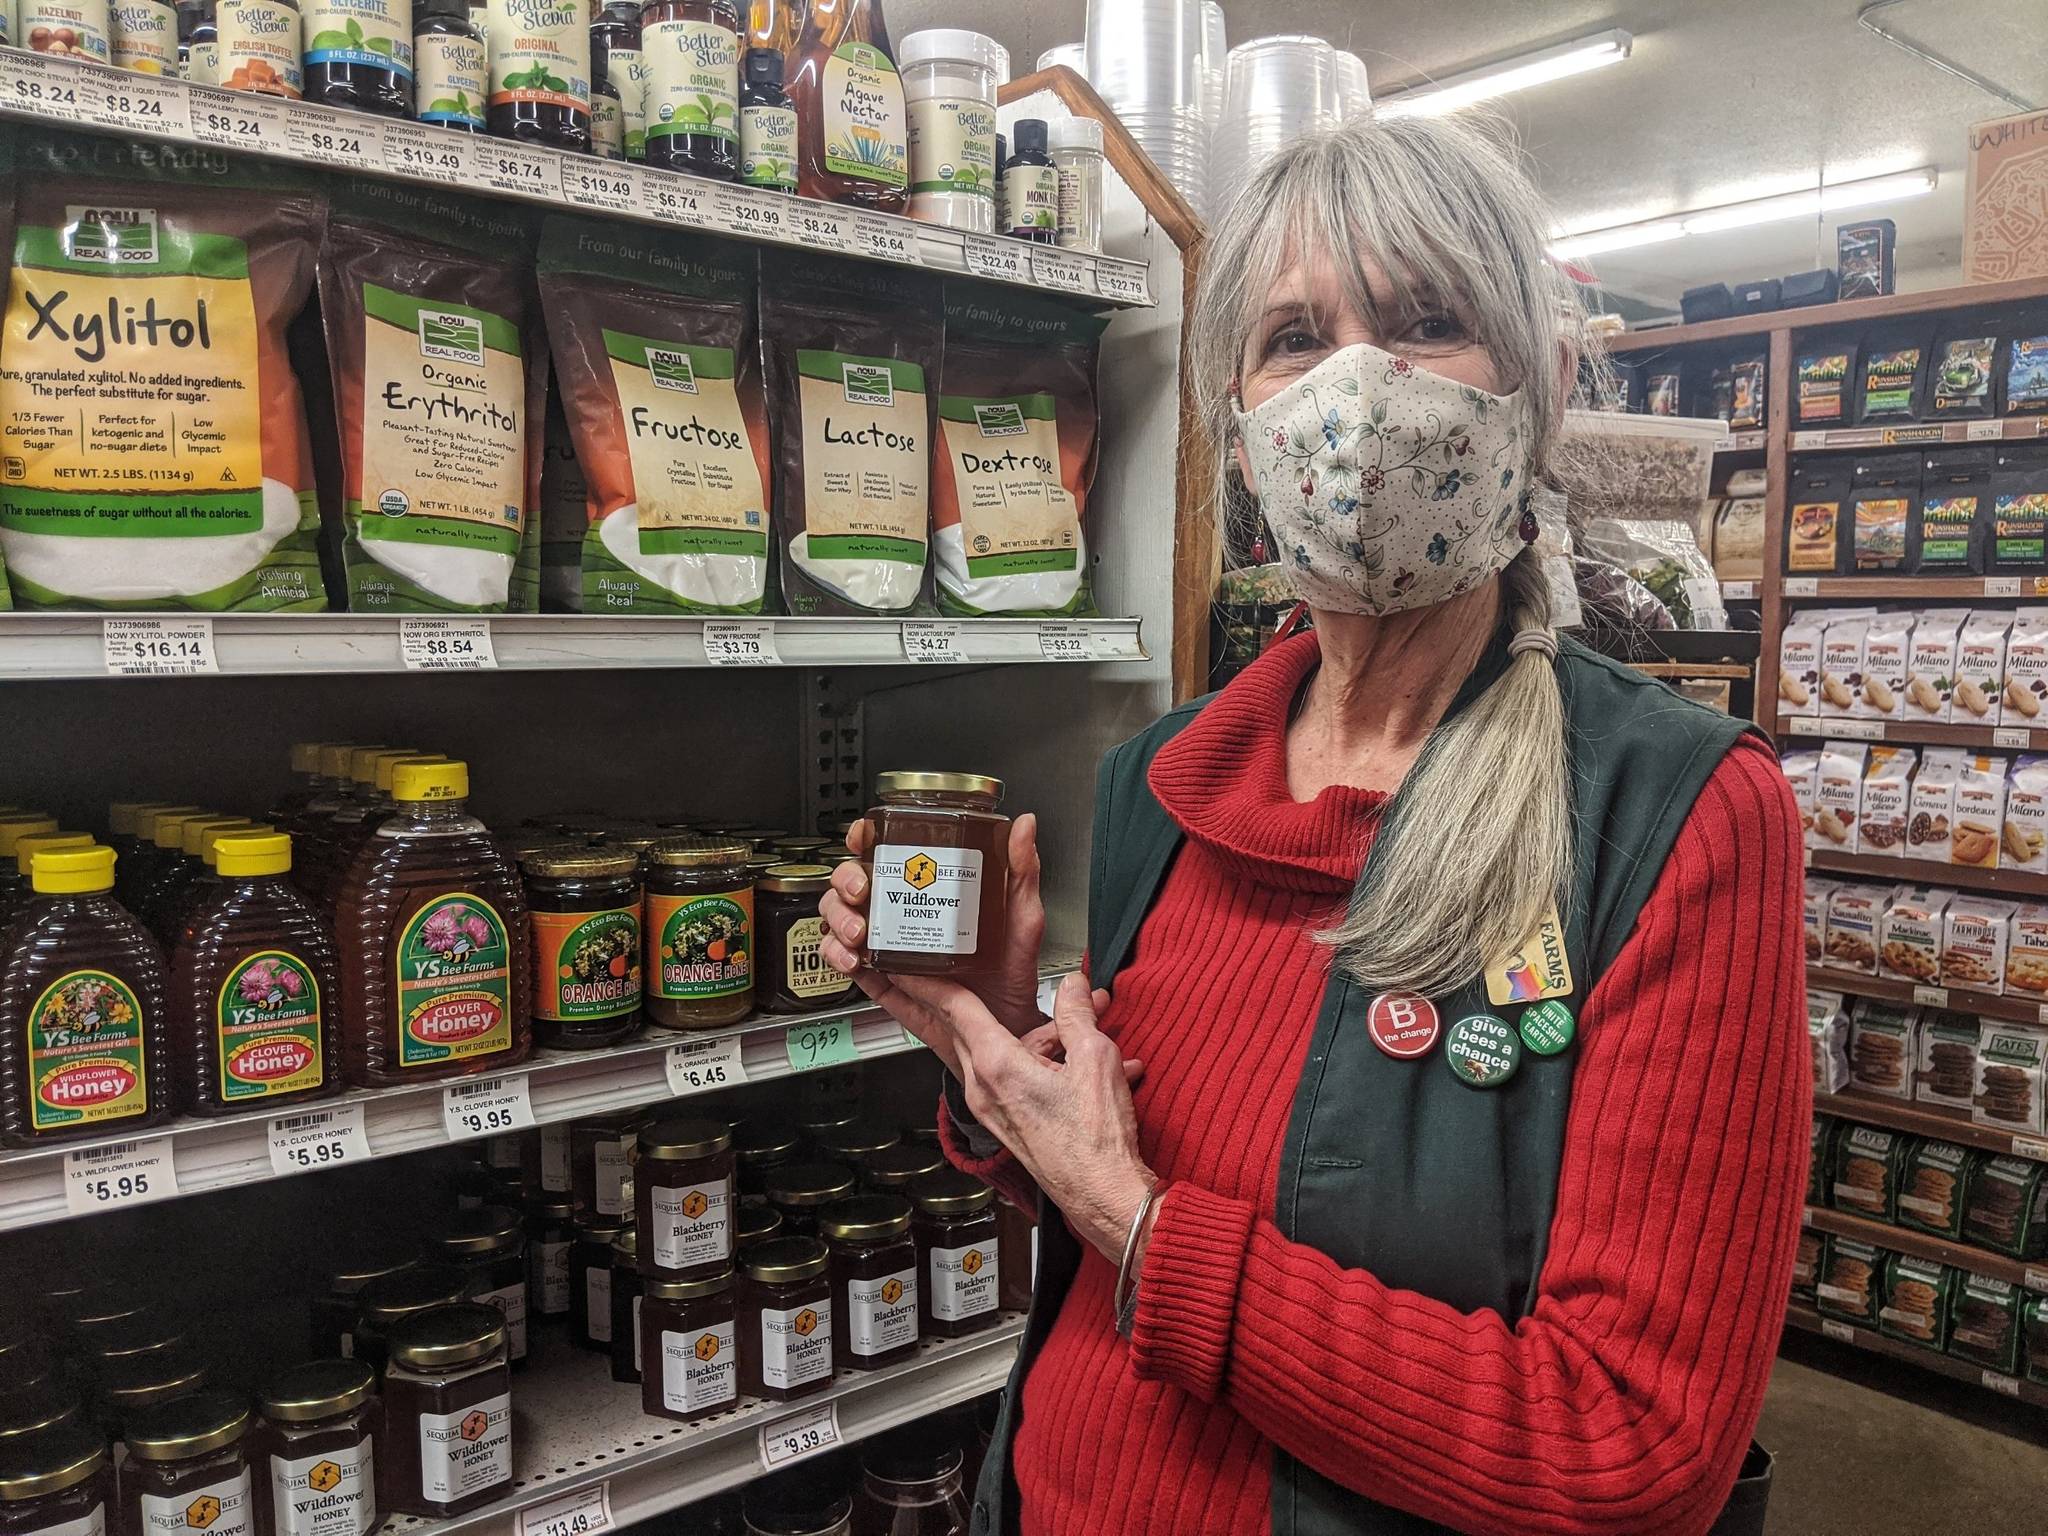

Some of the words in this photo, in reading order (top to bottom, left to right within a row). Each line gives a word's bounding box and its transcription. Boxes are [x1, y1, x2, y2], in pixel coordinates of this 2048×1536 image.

[38, 7, 82, 21] HAZELNUT
[236, 9, 275, 23] Better
[523, 8, 576, 30] Stevia
[250, 20, 289, 34] Stevia
[233, 41, 265, 52] ENGLISH
[267, 43, 292, 56] TOFFEE
[515, 39, 559, 52] ORIGINAL
[678, 34, 724, 52] Better
[697, 49, 735, 66] Stevia
[690, 75, 726, 90] ORGANIC
[847, 68, 881, 85] Organic
[16, 79, 77, 105] $8.24
[845, 83, 884, 105] Agave
[106, 95, 163, 117] $8.24
[840, 100, 890, 123] Nectar
[208, 114, 261, 137] $8.24
[312, 133, 360, 154] $8.24
[403, 147, 460, 169] $19.49
[499, 158, 542, 179] $6.74
[658, 184, 682, 194] STEVIA
[694, 189, 706, 197] EXT
[658, 192, 697, 210] $6.74
[736, 206, 778, 224] $20.99
[804, 219, 838, 235] $8.24
[872, 235, 904, 251] $6.64
[578, 234, 615, 254] From
[618, 246, 642, 259] our
[648, 249, 689, 276] family
[693, 263, 705, 276] to
[982, 255, 1017, 271] $22.49
[1047, 267, 1081, 283] $10.44
[1110, 278, 1142, 294] $22.79
[25, 290, 210, 363] Xylitol
[439, 316, 465, 326] now
[425, 346, 452, 357] REAL
[453, 350, 481, 362] FOOD
[25, 369, 86, 384] granulated
[88, 371, 126, 384] xylitol.
[129, 373, 146, 385] No
[149, 374, 182, 386] added
[184, 375, 245, 391] ingredients.
[422, 364, 487, 390] Organic
[32, 385, 53, 396] The
[55, 387, 96, 400] perfect
[99, 388, 154, 400] substitute
[157, 390, 173, 400] for
[176, 392, 210, 403] sugar.
[382, 382, 517, 434] Erythritol
[631, 407, 743, 450] Fructose
[824, 417, 915, 452] Lactose
[962, 450, 1052, 474] Dextrose
[54, 469, 77, 478] NET
[79, 469, 101, 478] WT.
[103, 469, 120, 479] 2.5
[123, 470, 147, 480] LBS.
[149, 470, 180, 481] (1134
[180, 471, 194, 482] g)
[3, 505, 23, 516] The
[25, 507, 81, 518] sweetness
[84, 507, 95, 517] of
[98, 508, 129, 520] sugar
[133, 507, 171, 518] without
[175, 507, 187, 518] all
[190, 507, 206, 518] the
[208, 508, 251, 519] calories.
[262, 586, 309, 599] Artificial
[598, 579, 640, 594] Always
[607, 594, 633, 606] Real
[106, 632, 128, 640] NOW
[130, 632, 165, 640] XYLITOL
[167, 632, 205, 640] POWDER
[404, 631, 422, 639] NOW
[424, 631, 440, 639] ORG
[135, 642, 200, 659] $16.14
[427, 640, 473, 654] $8.54
[723, 641, 760, 655] $3.79
[920, 639, 949, 650] $4.27
[1055, 640, 1080, 650] $5.22
[1824, 654, 1858, 664] Milano
[1912, 654, 1950, 666] Milano
[1913, 795, 1947, 810] Geneva
[1956, 803, 1997, 817] bordeaux
[2008, 803, 2045, 817] Milano
[938, 869, 954, 877] BEE
[957, 870, 977, 878] FARM
[886, 891, 961, 907] Wildflower
[903, 909, 941, 919] HONEY
[1831, 907, 1872, 923] Sausalito
[1891, 923, 1931, 937] Mackinac
[1952, 924, 1997, 938] FARMHOUSE
[1540, 921, 1567, 989] FARMS
[414, 959, 440, 979] YS
[441, 963, 461, 975] Bee
[463, 959, 495, 972] Farms
[664, 963, 722, 981] ORANGE
[414, 977, 448, 988] Nature's
[449, 973, 481, 984] Sweetest
[482, 971, 499, 980] Gift
[793, 975, 817, 987] RAW
[820, 974, 827, 982] &
[426, 997, 448, 1008] Pure
[449, 992, 487, 1001] Premium
[562, 980, 623, 1004] ORANGE
[434, 1003, 481, 1017] CLOVER
[1387, 999, 1417, 1030] B
[1541, 1005, 1564, 1029] UNITE
[421, 1010, 493, 1035] Honey
[1471, 1019, 1508, 1038] give
[1526, 1007, 1566, 1045] SPACESHIP
[1384, 1034, 1399, 1042] the
[1400, 1028, 1432, 1040] change
[1458, 1027, 1497, 1050] bees
[1503, 1044, 1512, 1056] a
[1525, 1022, 1551, 1048] EARTH!
[250, 1045, 294, 1058] CLOVER
[1451, 1042, 1511, 1070] chance
[239, 1051, 307, 1074] Honey
[684, 1058, 708, 1069] ORANGE
[710, 1054, 731, 1064] HONEY
[60, 1069, 117, 1083] WILDFLOWER
[683, 1066, 726, 1087] $6.45
[51, 1077, 127, 1101] Honey
[465, 1101, 494, 1111] CLOVER
[495, 1096, 519, 1105] HONEY
[462, 1109, 512, 1132] $9.95
[290, 1133, 324, 1145] CLOVER
[325, 1128, 353, 1138] HONEY
[288, 1142, 345, 1166] $5.95
[85, 1162, 134, 1177] WILDFLOWER
[135, 1158, 160, 1168] HONEY
[86, 1174, 149, 1201] $5.95
[672, 1218, 726, 1237] Blackberry
[684, 1231, 714, 1243] HONEY
[955, 1273, 996, 1291] Blackberry
[874, 1304, 916, 1323] Blackberry
[883, 1314, 908, 1328] HONEY
[666, 1346, 693, 1357] SEQUIM
[786, 1335, 832, 1355] Blackberry
[796, 1348, 822, 1360] HONEY
[686, 1360, 736, 1380] Blackberry
[697, 1372, 724, 1385] HONEY
[426, 1429, 459, 1440] SEQUIM
[784, 1430, 820, 1454] $9.39
[448, 1432, 509, 1462] Wildflower
[463, 1450, 494, 1468] HONEY
[294, 1488, 365, 1514] Wildflower
[314, 1507, 351, 1523] HONEY
[546, 1514, 588, 1536] $13.49
